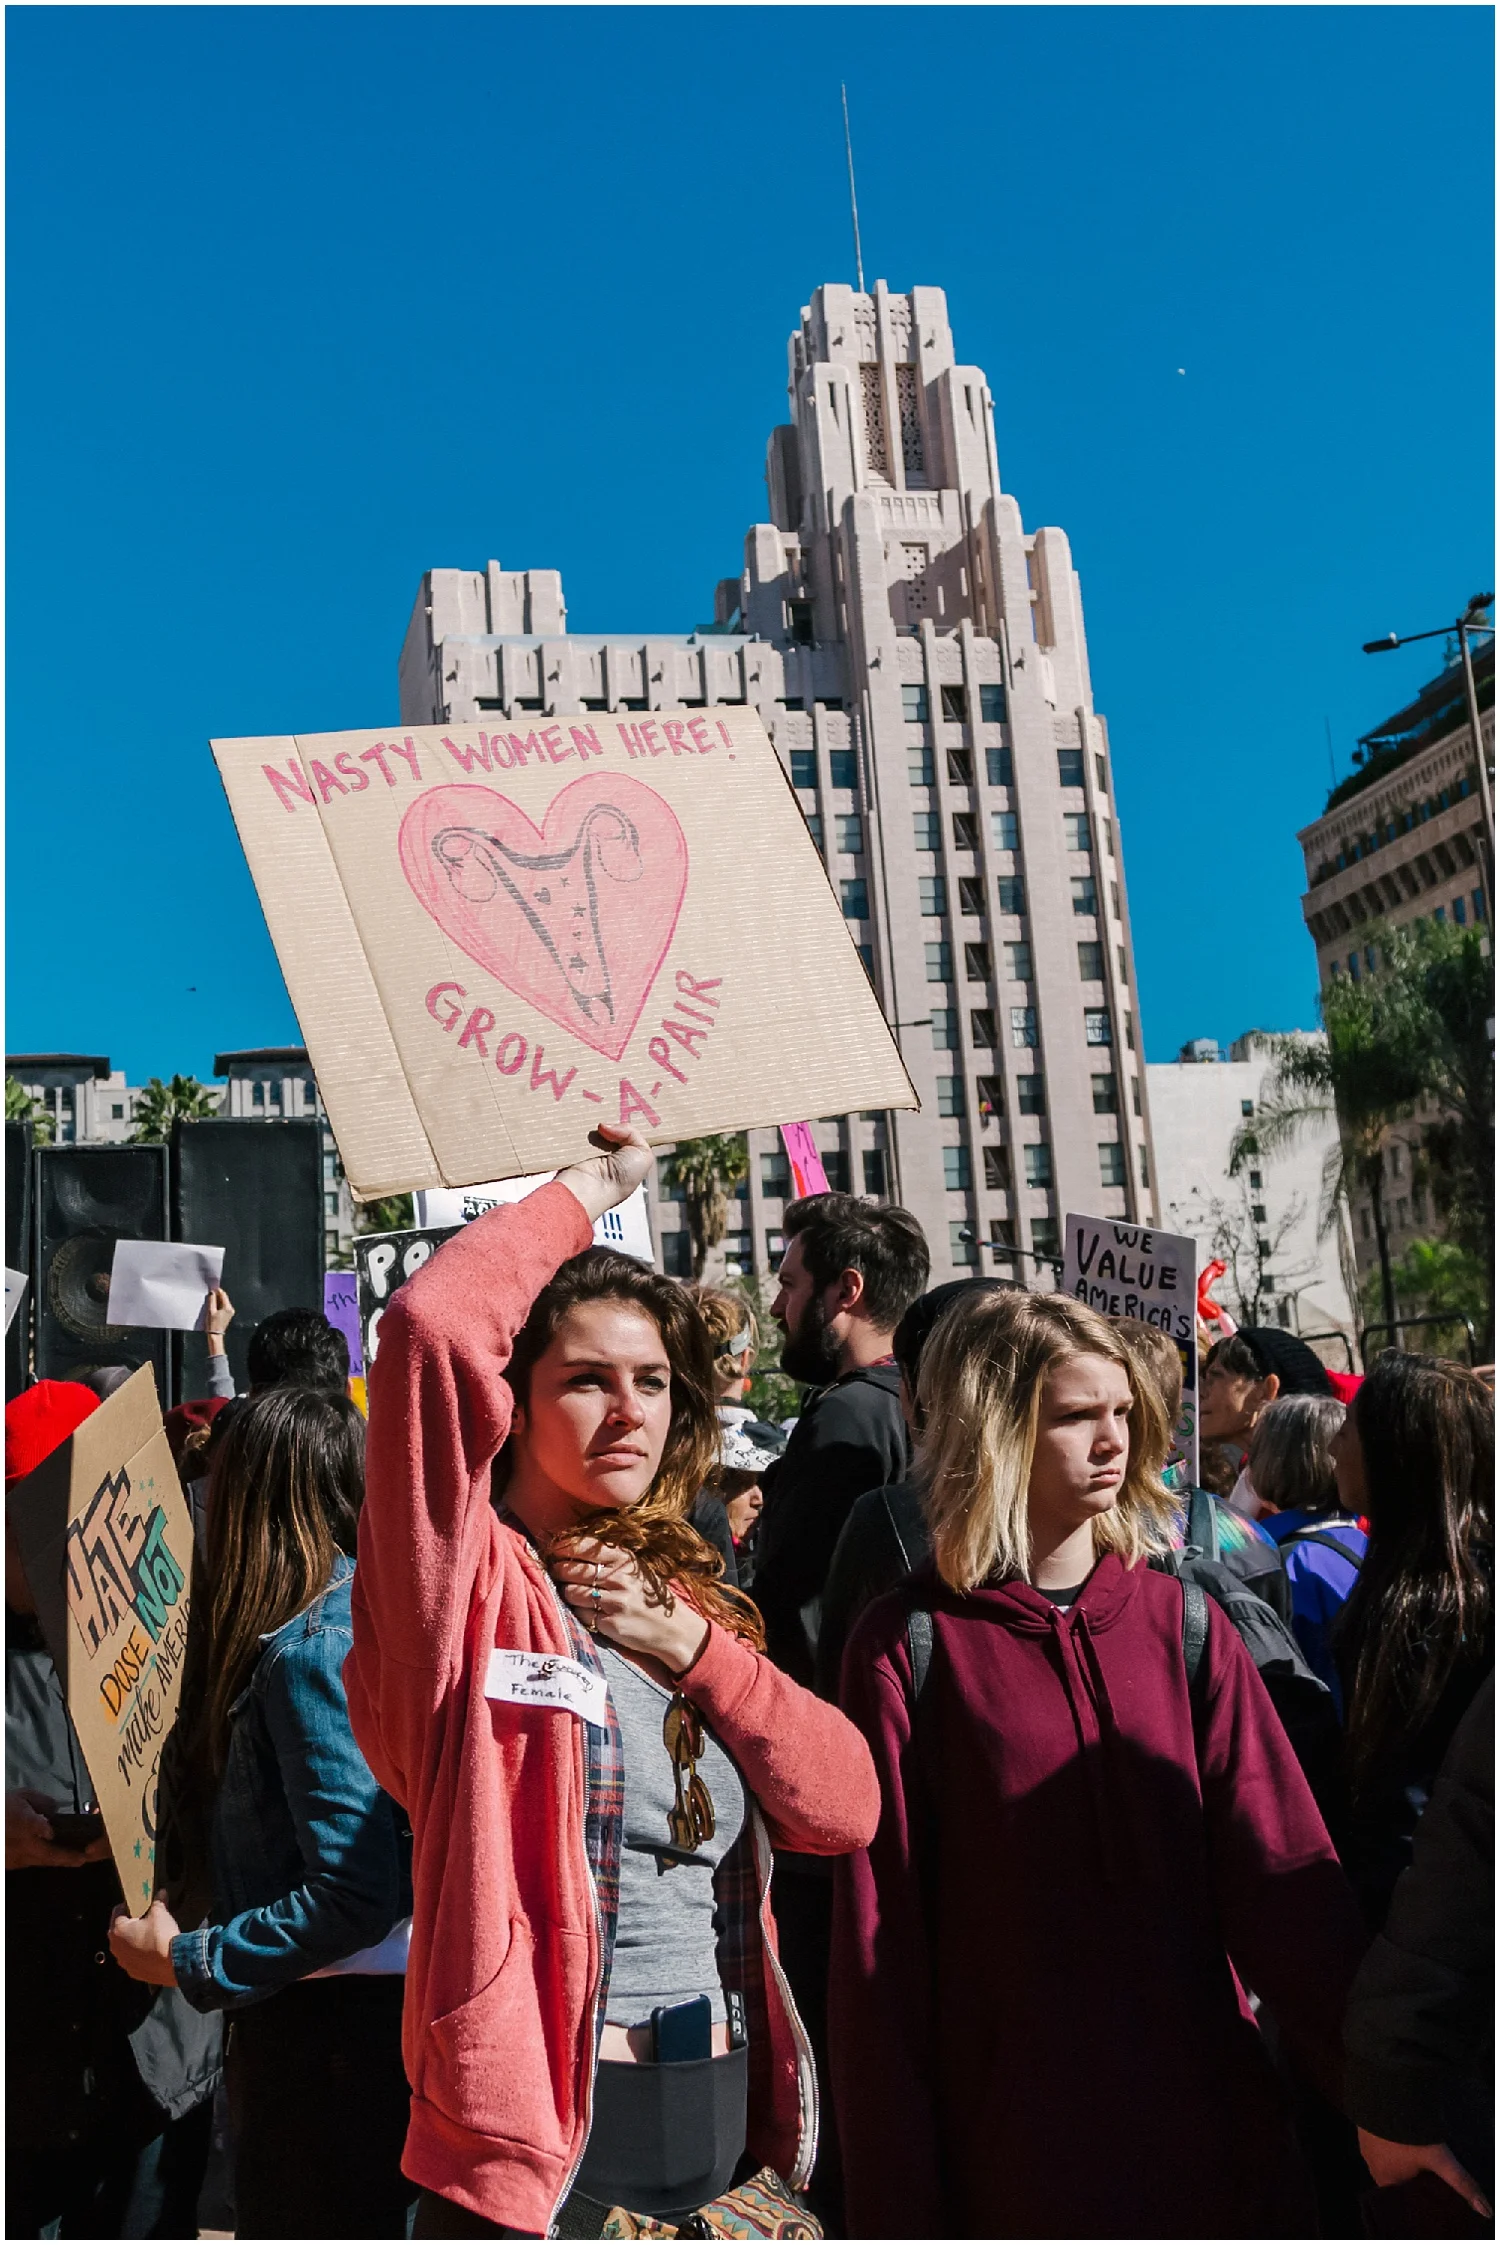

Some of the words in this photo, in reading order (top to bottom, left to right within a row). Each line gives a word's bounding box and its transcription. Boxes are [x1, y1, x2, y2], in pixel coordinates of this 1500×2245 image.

[261, 735, 422, 813] NASTY
[439, 724, 604, 774] WOMEN
[616, 715, 736, 761] HERE!
[1077, 1228, 1177, 1290] VALUE
[1113, 1226, 1153, 1254] WE
[1075, 1278, 1191, 1338] AMERICA'S
[67, 1465, 147, 1661] HATE
[135, 1504, 185, 1645] NOT
[99, 1625, 150, 1717] DOSE
[505, 1654, 540, 1669] The
[511, 1683, 574, 1703] Female
[117, 1685, 164, 1787] make
